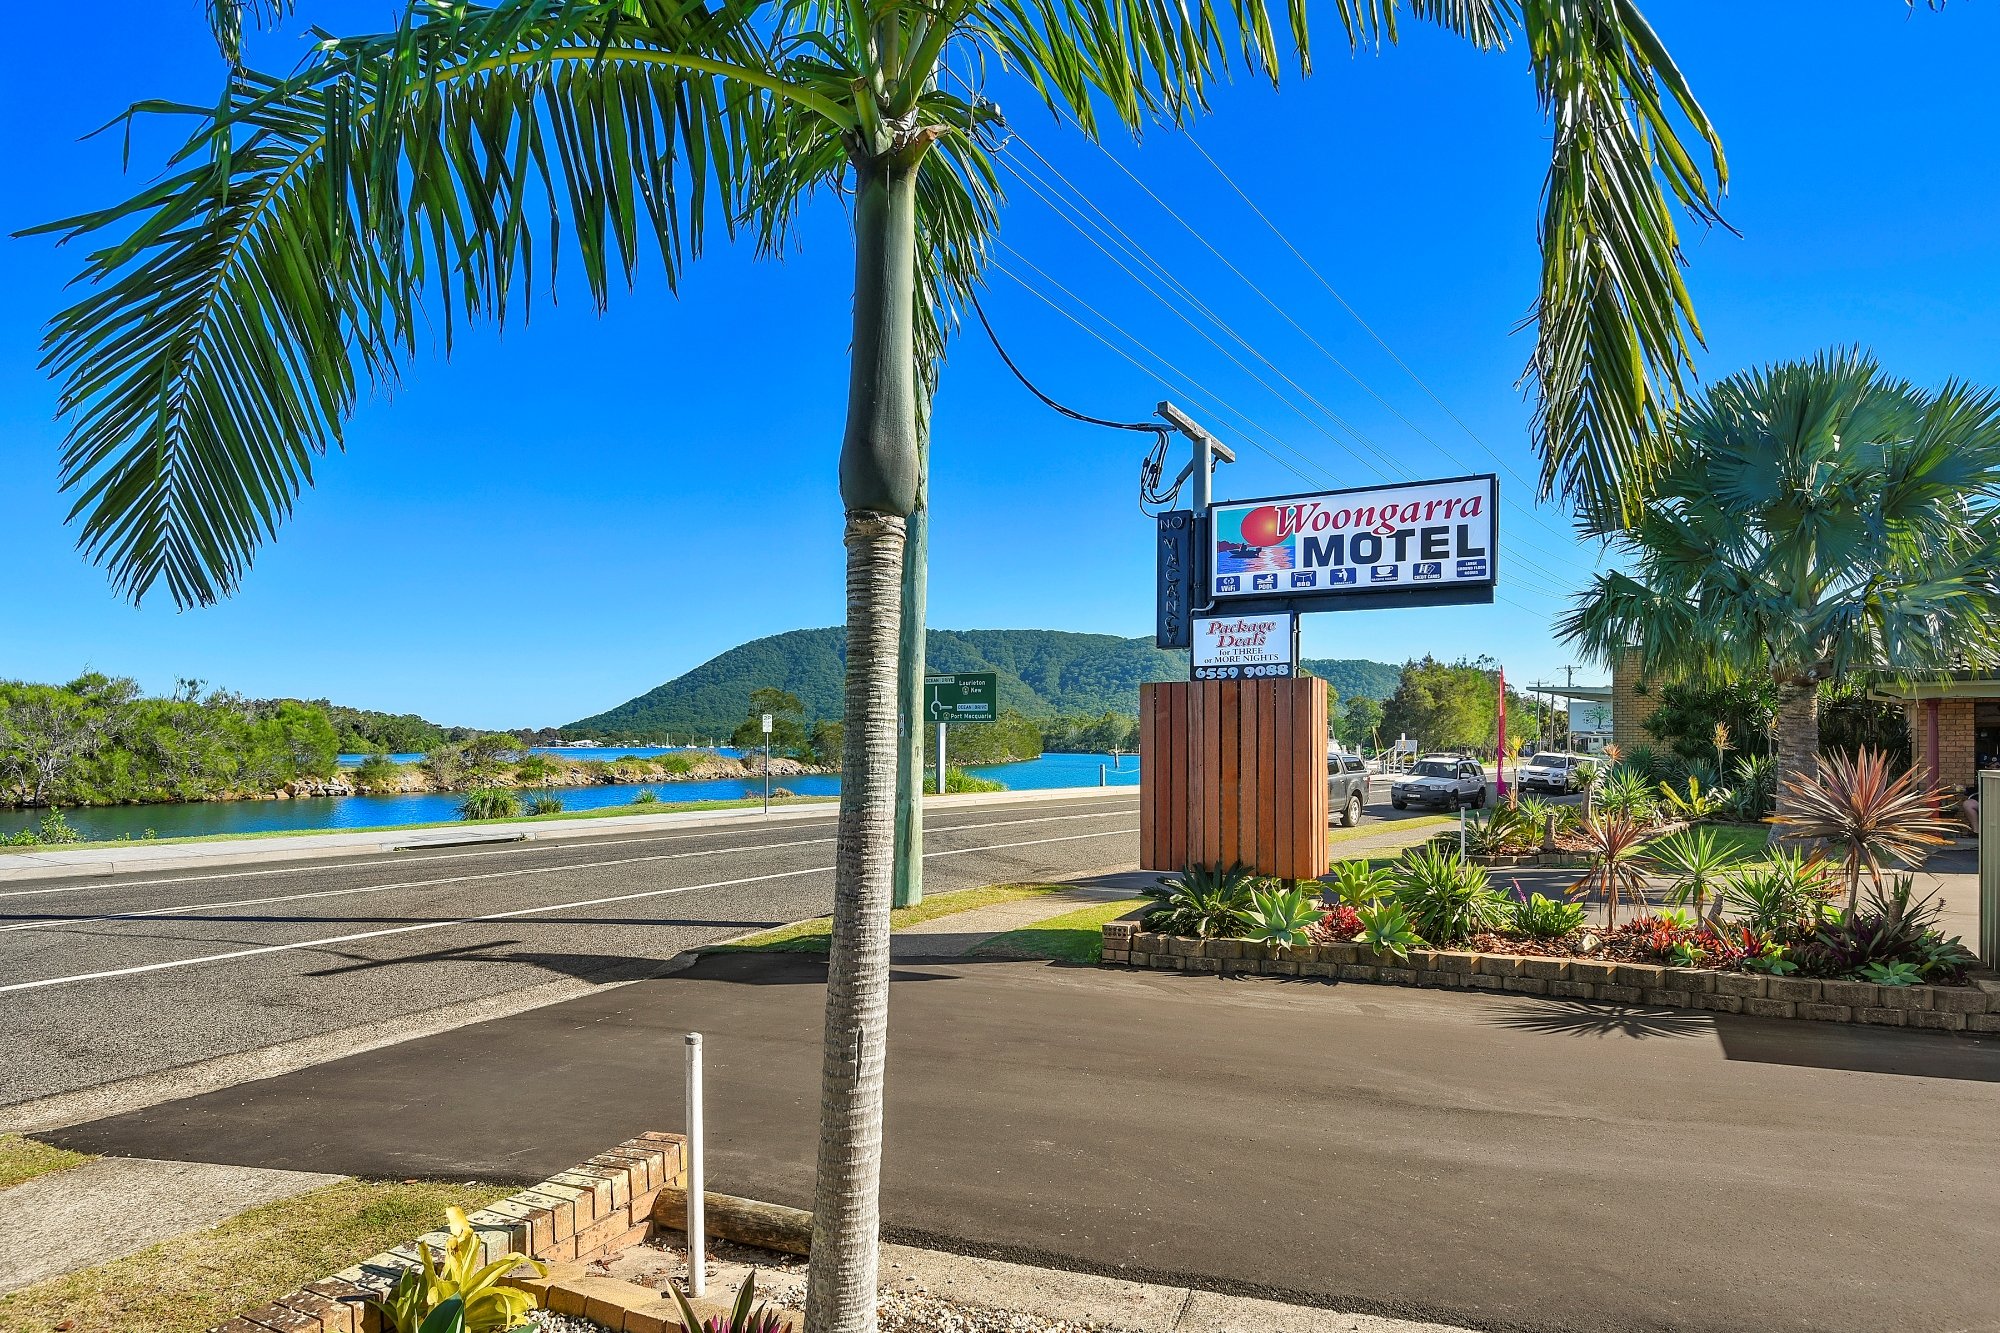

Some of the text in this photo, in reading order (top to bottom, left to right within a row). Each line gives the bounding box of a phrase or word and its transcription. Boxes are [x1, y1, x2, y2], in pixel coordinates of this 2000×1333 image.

[1160, 516, 1183, 531] NO
[1274, 495, 1483, 536] Woongarra
[1303, 524, 1486, 569] MOTEL
[1163, 537, 1178, 643] VACANCY
[1206, 619, 1277, 636] Package
[1216, 633, 1266, 648] Deals
[1214, 655, 1240, 663] MORE
[1243, 654, 1279, 662] NIGHTS
[1195, 664, 1289, 680] 6559 9088
